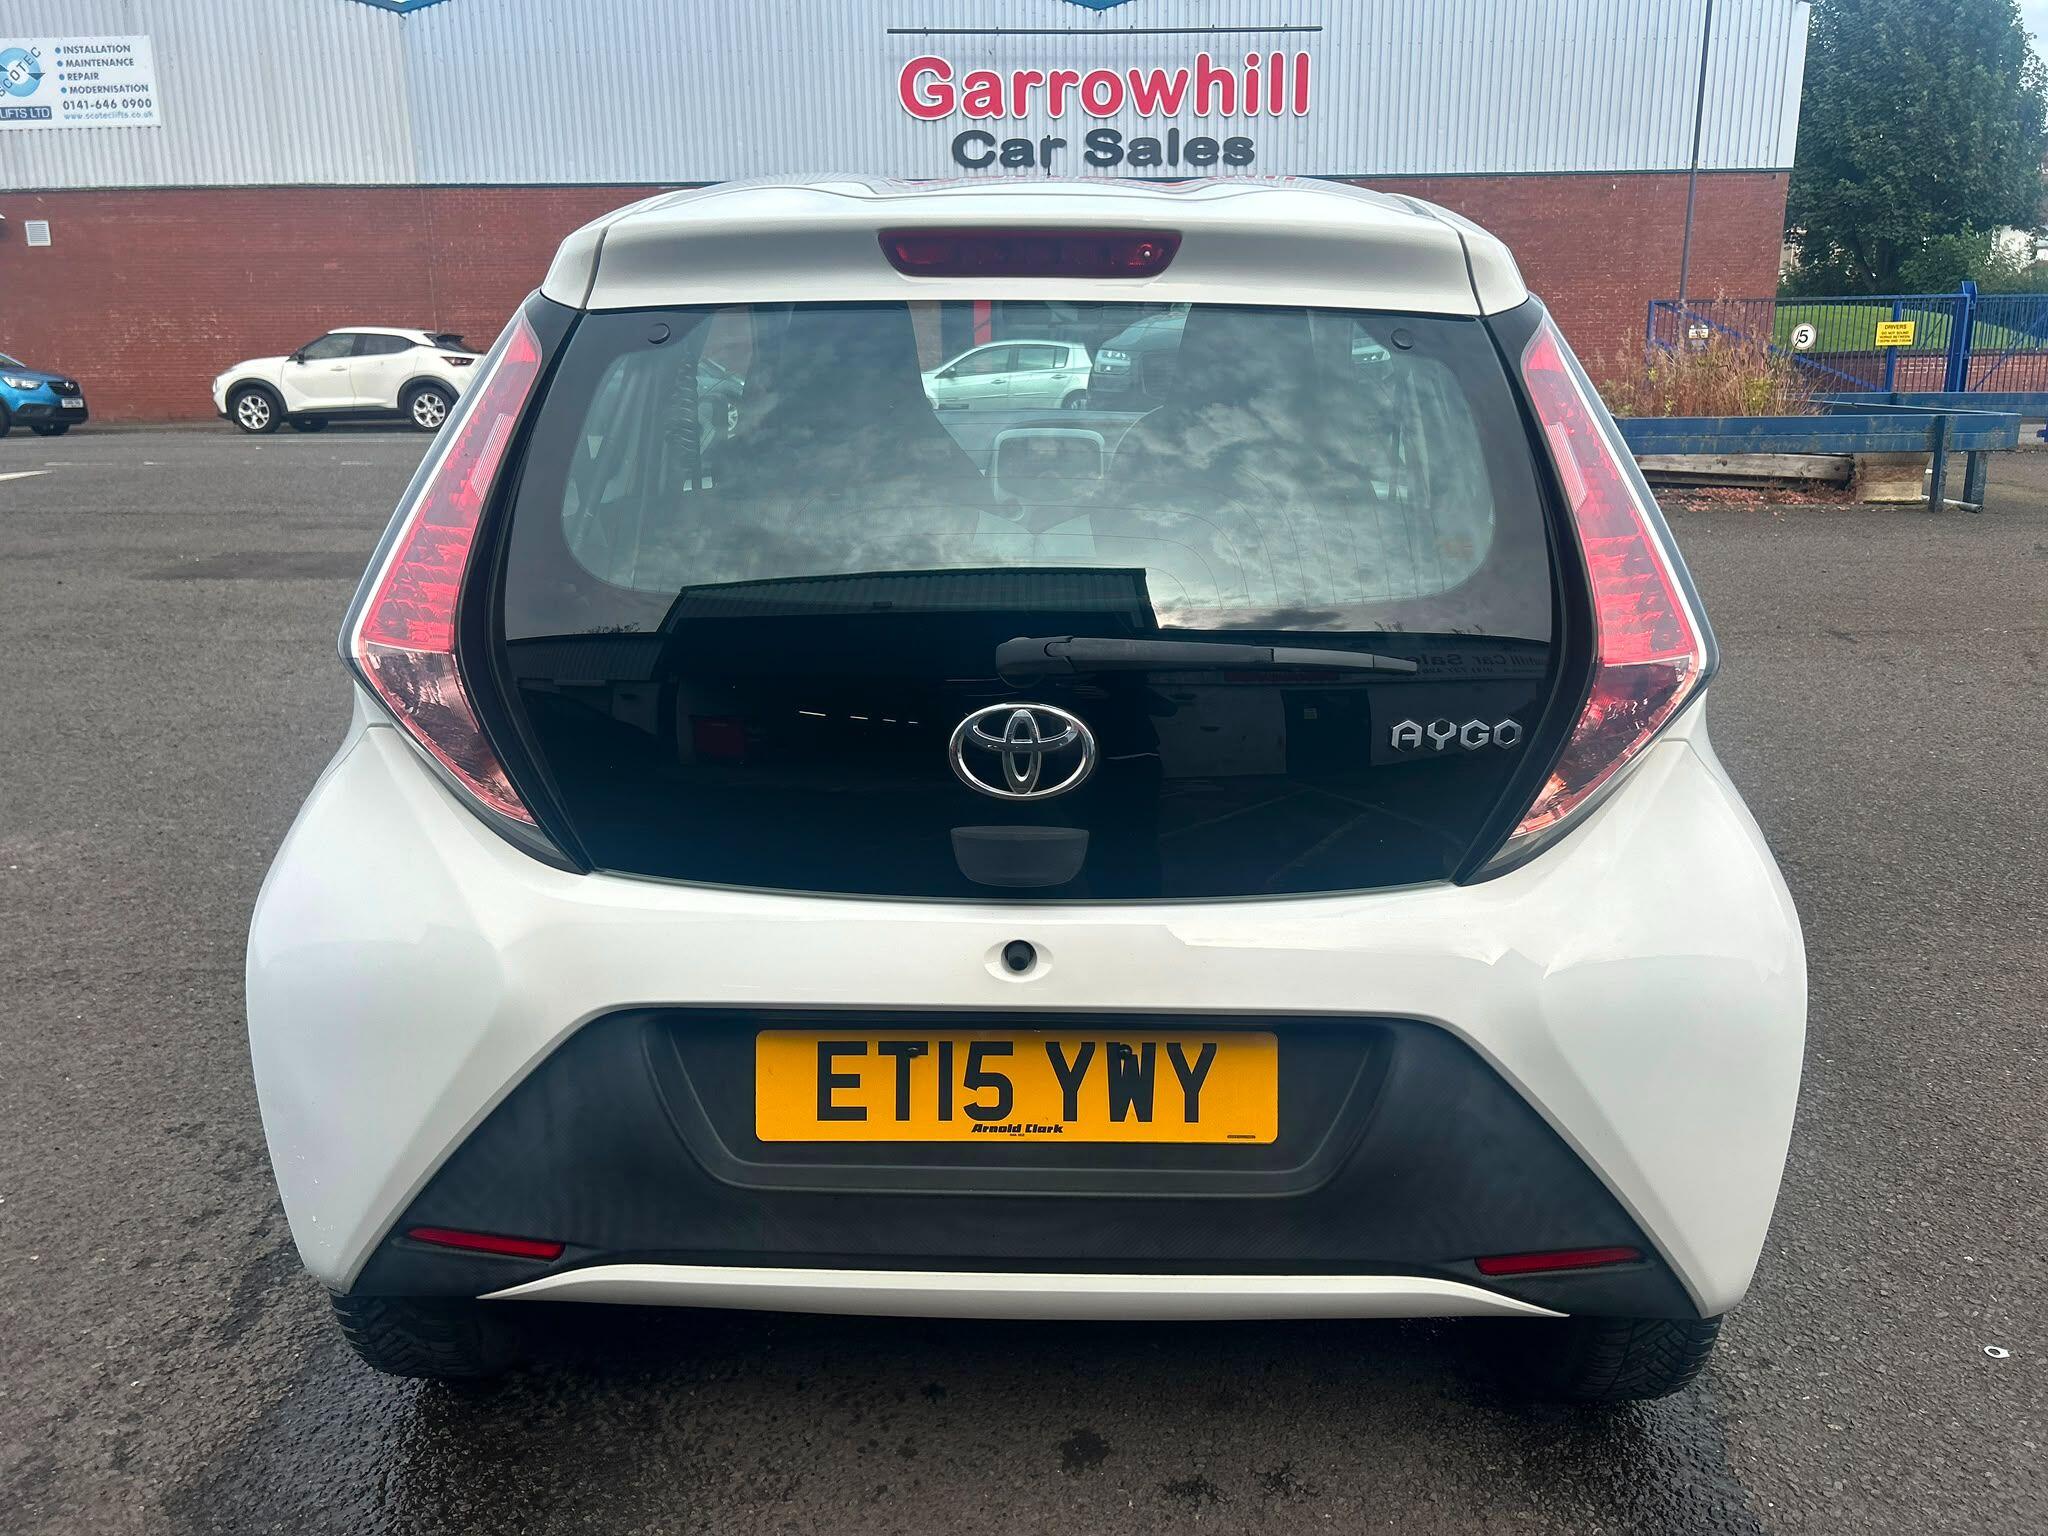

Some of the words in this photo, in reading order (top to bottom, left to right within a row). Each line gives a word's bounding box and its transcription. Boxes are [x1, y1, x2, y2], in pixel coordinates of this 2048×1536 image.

[63, 45, 131, 54] INSTALLATION
[65, 58, 134, 67] MAINTENANCE
[67, 72, 100, 81] REPAIR
[69, 84, 149, 94] MODERNISATION
[899, 51, 1311, 120] Garrowhill
[62, 98, 117, 110] 0141-646
[122, 98, 152, 109] 0900
[0, 109, 28, 119] LIFTS
[30, 108, 50, 118] LTD
[952, 129, 1067, 168] Car
[1084, 127, 1255, 167] Sales
[1391, 719, 1523, 751] AYGO
[816, 1040, 1014, 1122] ET15
[1045, 1041, 1218, 1123] YWY
[971, 1123, 1022, 1133] Arnold
[1025, 1123, 1063, 1133] Clark
